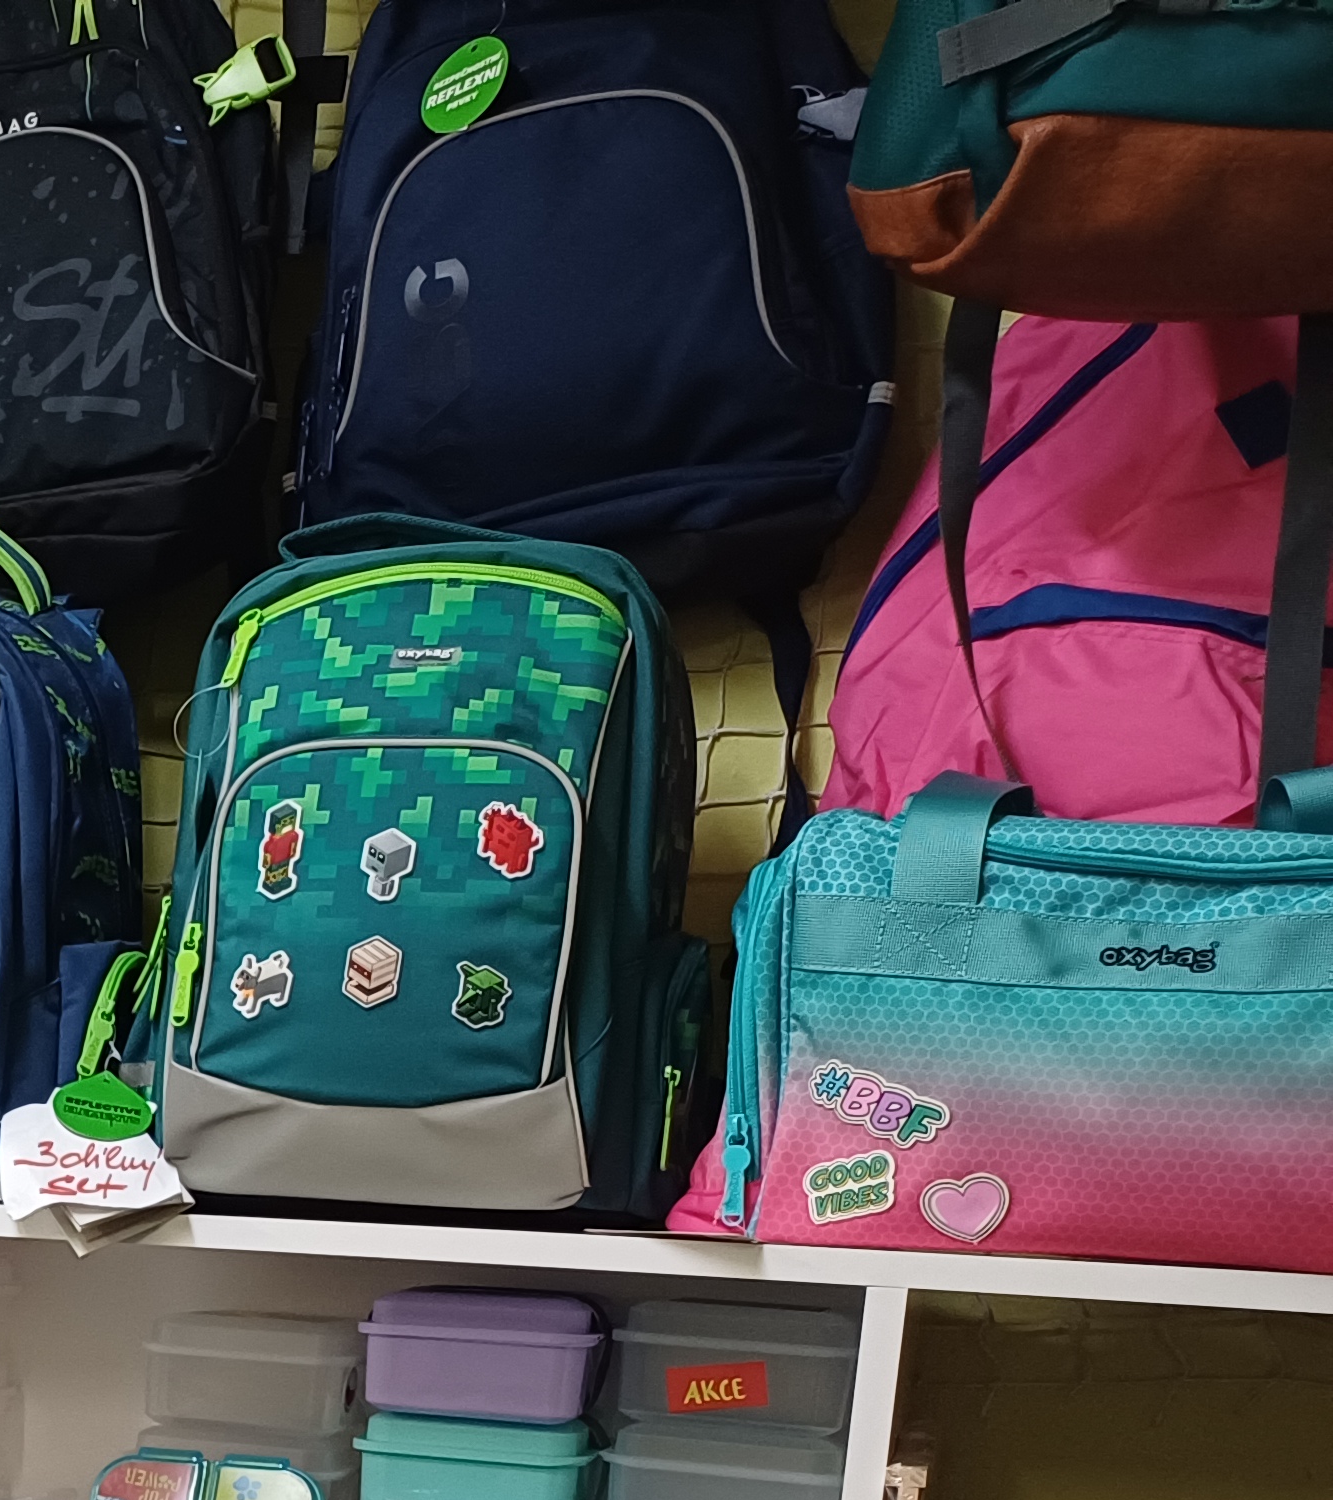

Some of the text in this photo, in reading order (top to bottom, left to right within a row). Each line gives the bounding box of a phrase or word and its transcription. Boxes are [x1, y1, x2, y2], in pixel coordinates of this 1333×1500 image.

[426, 60, 505, 109] REFLEXNÍ
[1099, 941, 1219, 973] oxybag
[813, 1064, 947, 1143] #BBF
[810, 1155, 888, 1192] GOOD
[814, 1182, 889, 1218] VIBES
[684, 1378, 747, 1405] AKCE
